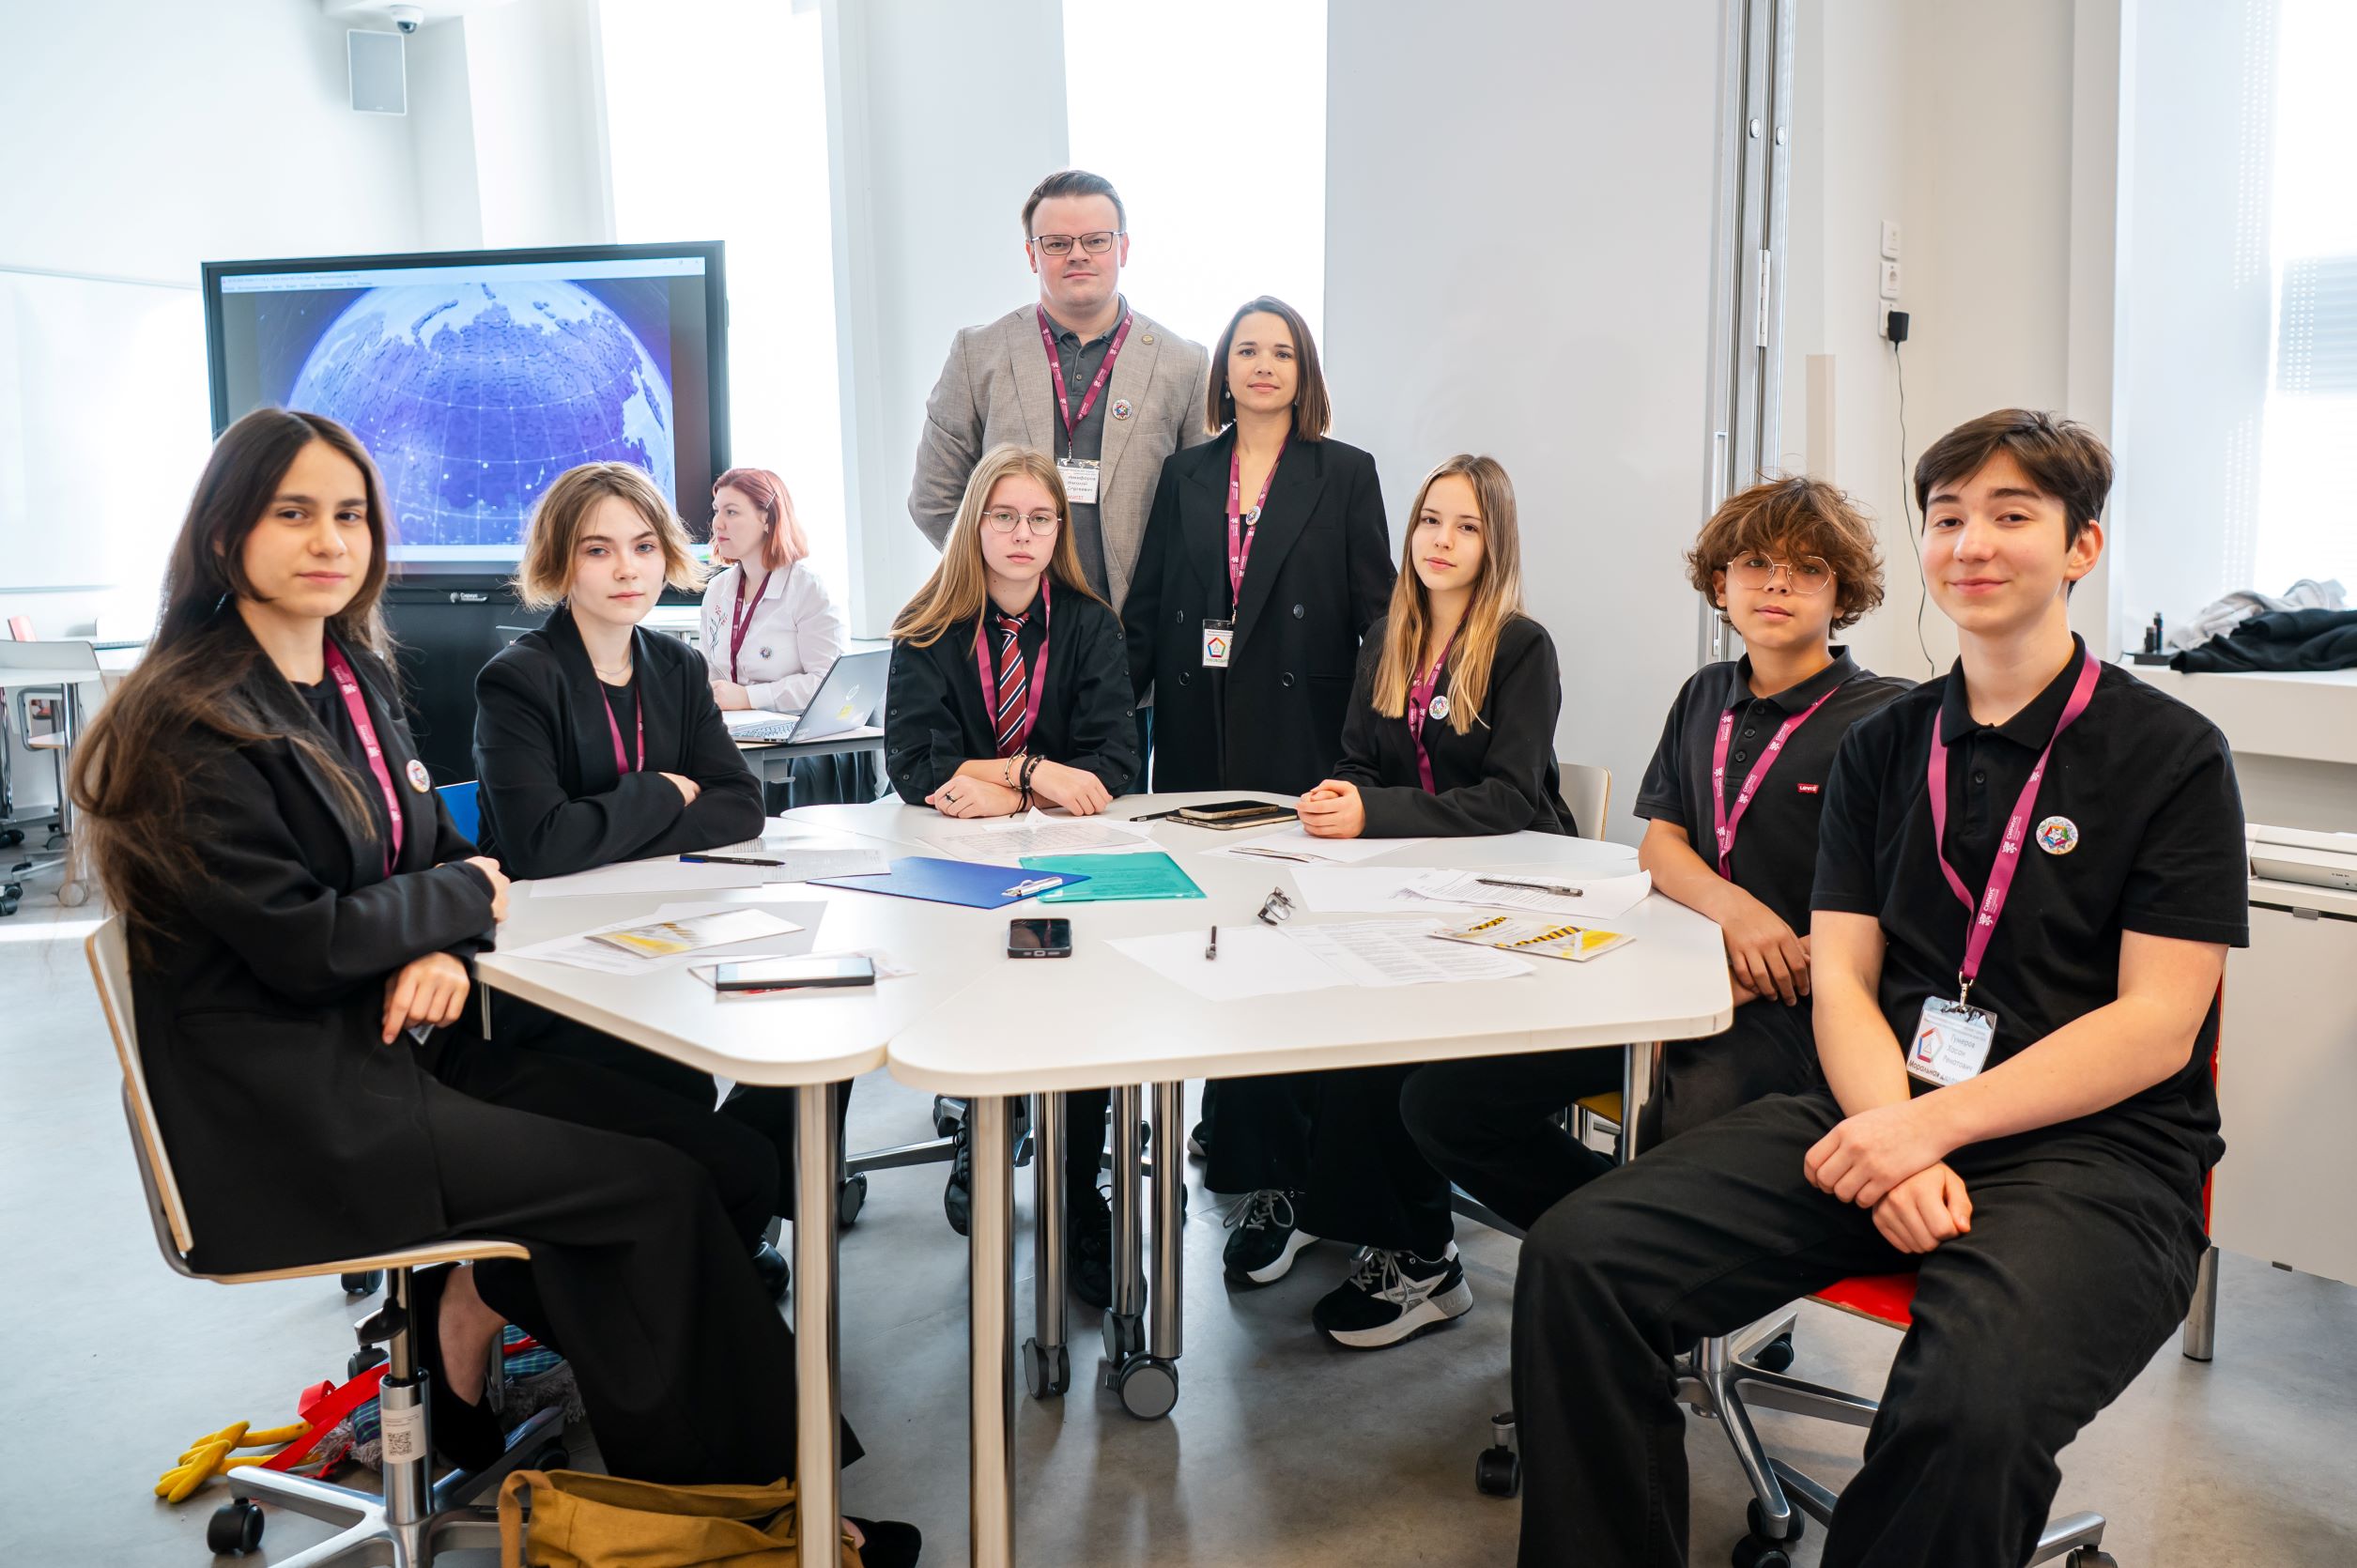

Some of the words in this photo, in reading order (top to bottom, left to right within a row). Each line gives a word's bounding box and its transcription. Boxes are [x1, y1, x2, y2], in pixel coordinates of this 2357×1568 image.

[2007, 816, 2018, 839] СИРИУС
[1984, 887, 1995, 911] СИРИУС
[1908, 1059, 1940, 1078] Моральная
